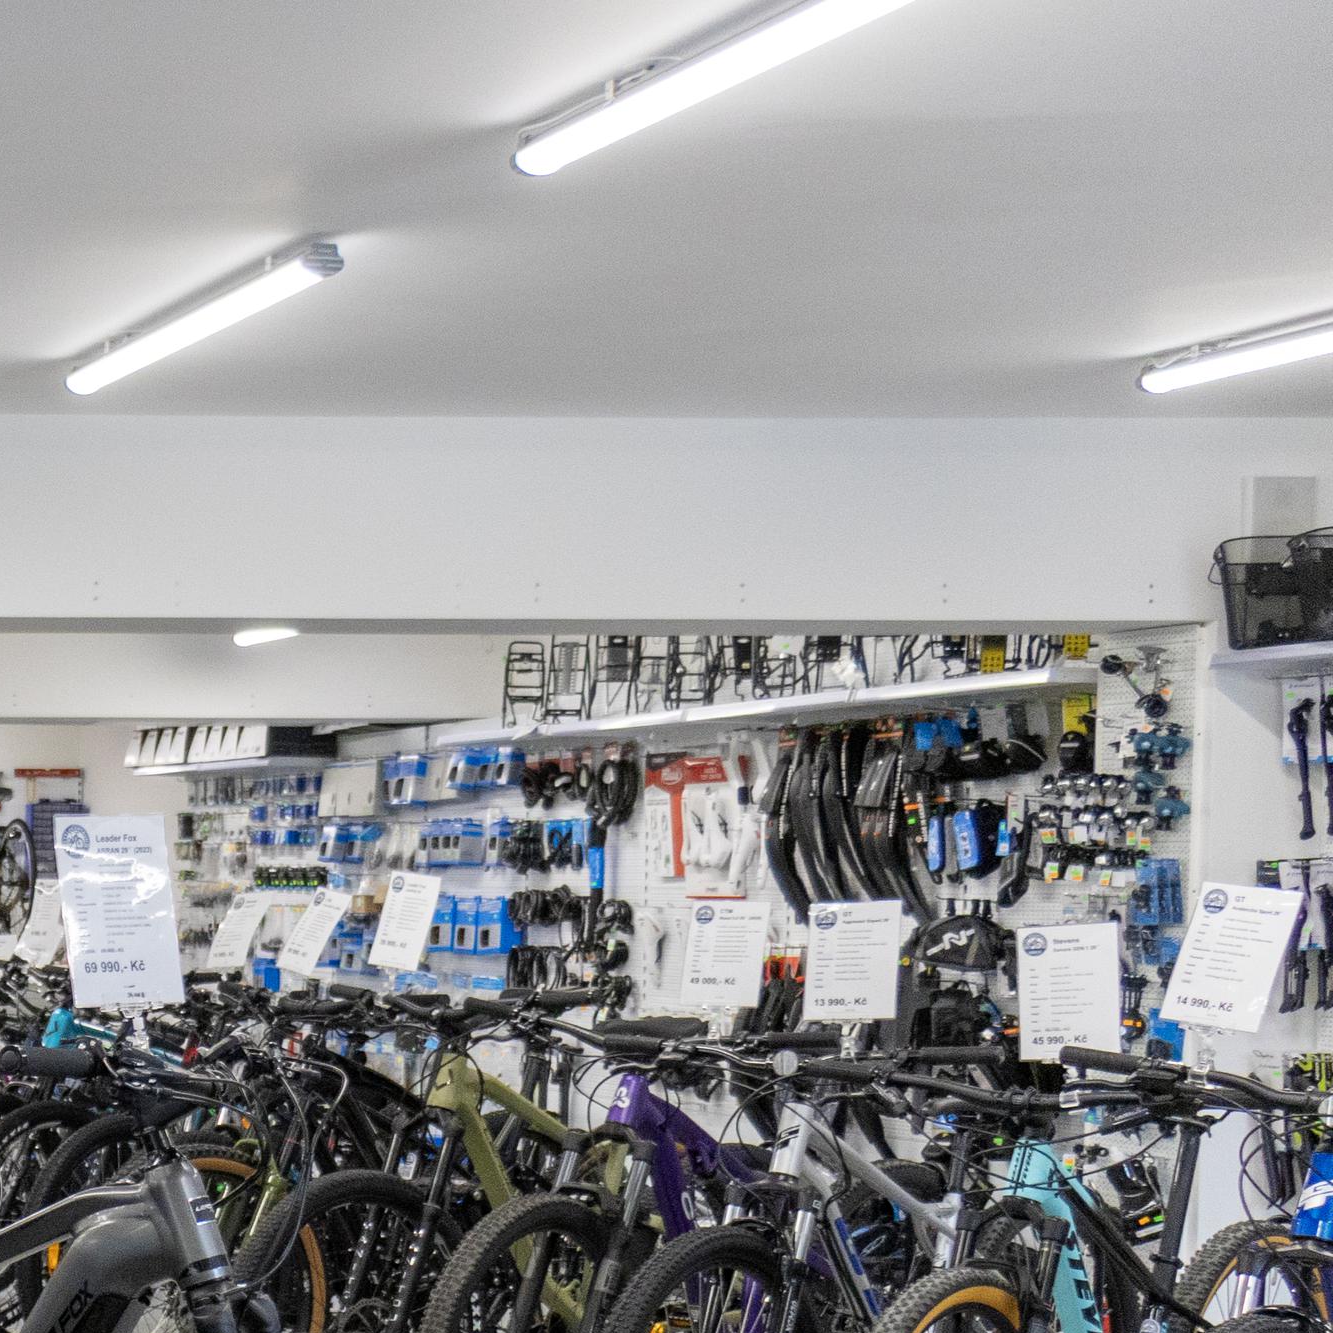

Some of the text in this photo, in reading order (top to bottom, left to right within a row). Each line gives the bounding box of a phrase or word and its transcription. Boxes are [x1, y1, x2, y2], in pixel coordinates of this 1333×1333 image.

[95, 834, 137, 843] Leader Fox
[84, 960, 145, 974] 69 990,- Kč
[724, 977, 736, 985] Kč
[814, 997, 867, 1007] 13 990,- Kč
[1176, 995, 1233, 1012] 14 990,- Kč
[1032, 1034, 1088, 1045] 45 990,- Kč
